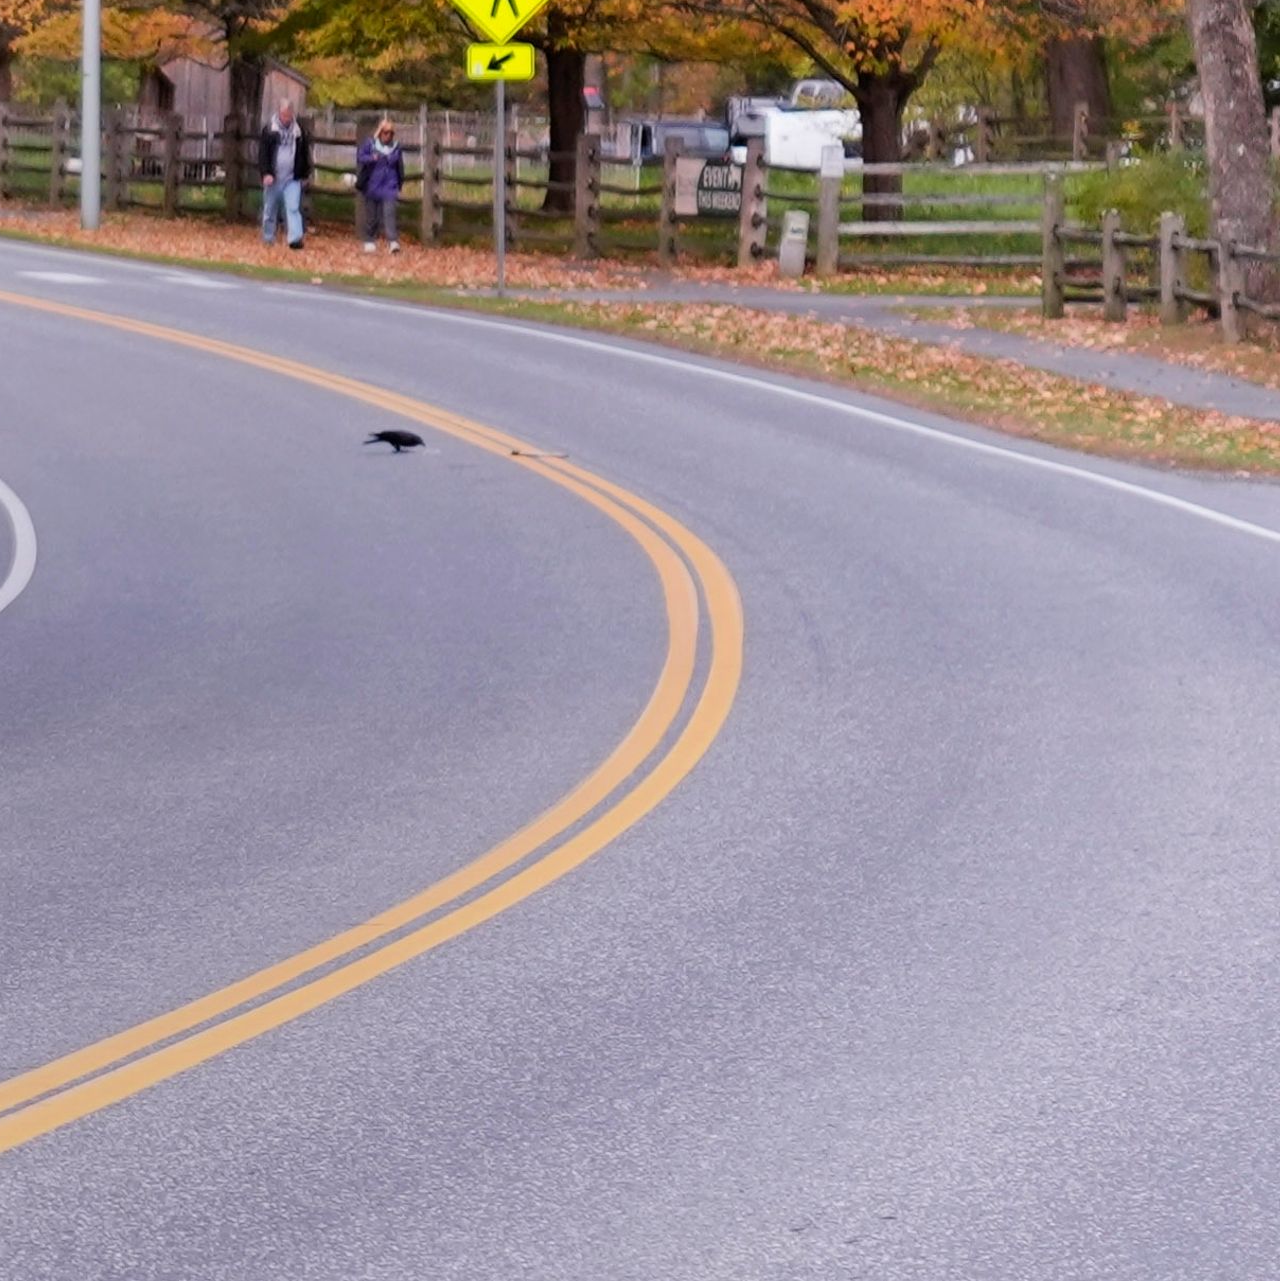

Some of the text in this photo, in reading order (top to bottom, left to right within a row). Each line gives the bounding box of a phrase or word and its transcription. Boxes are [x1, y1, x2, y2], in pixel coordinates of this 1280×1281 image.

[704, 166, 728, 189] EVENT
[698, 191, 741, 210] THIS WEEKEND
